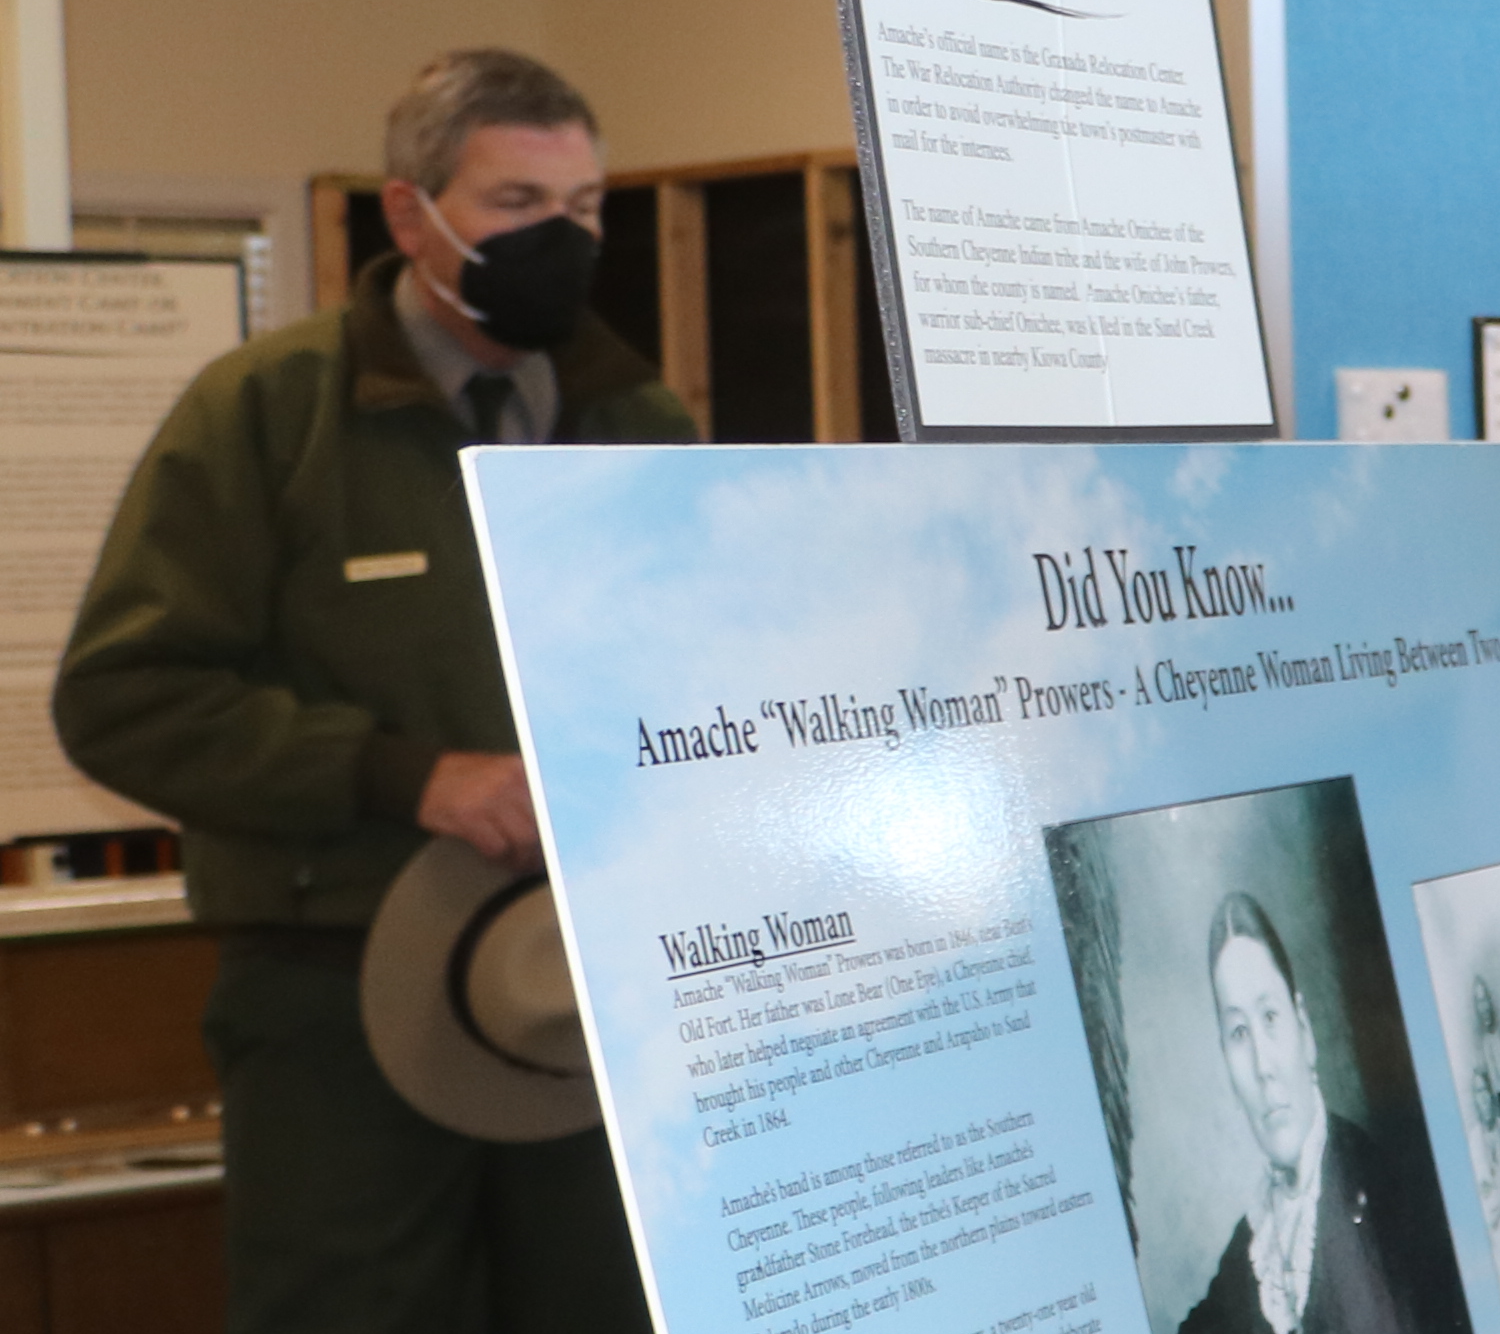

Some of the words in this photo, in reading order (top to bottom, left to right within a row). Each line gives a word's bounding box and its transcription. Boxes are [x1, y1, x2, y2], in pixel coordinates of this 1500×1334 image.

[1033, 546, 1108, 631] Did
[1104, 549, 1177, 624] You
[1173, 545, 1294, 619] Know...
[636, 706, 758, 767] Amache
[760, 694, 901, 747] “Walking
[896, 676, 1007, 732] Woman”
[1013, 676, 1114, 720] Prowers
[1134, 665, 1153, 706] A
[1153, 659, 1258, 703] Cheyenne
[1255, 650, 1335, 688] Woman
[1332, 642, 1397, 684] Living
[1392, 636, 1469, 674] Between
[658, 924, 766, 971] Walking
[761, 911, 854, 950] Woman
[673, 979, 725, 1009] Amache
[723, 969, 785, 994] “Walking
[780, 953, 832, 983] Woman”
[833, 950, 883, 973] Prowers
[882, 945, 906, 961] was
[903, 938, 935, 958] born
[933, 937, 948, 952] in
[678, 1017, 706, 1044] Old
[704, 1015, 738, 1038] Fort.
[736, 1007, 763, 1030] Her
[763, 999, 800, 1024] father
[800, 997, 825, 1014] was
[823, 989, 857, 1010] Lone
[854, 982, 883, 1003] Bear
[884, 974, 915, 999] (One
[1006, 944, 1035, 969] chief,
[686, 1054, 716, 1078] who
[714, 1050, 745, 1071] later
[744, 1034, 789, 1067] helped
[839, 1025, 857, 1041] an
[856, 1009, 916, 1042] agreement
[914, 998, 942, 1021] with
[941, 995, 961, 1016] the
[958, 989, 984, 1011] U.S.
[985, 986, 1014, 1005] Army
[1014, 979, 1037, 998] that
[692, 1082, 746, 1114] brought
[744, 1078, 767, 1100] his
[766, 1066, 808, 1102] people
[808, 1058, 833, 1084] and
[833, 1053, 865, 1078] other
[864, 1042, 922, 1070] Cheyenne
[922, 1030, 945, 1055] and
[946, 1021, 991, 1051] Arapaho
[1003, 1009, 1032, 1034] Sand
[702, 1118, 742, 1147] Creek
[741, 1117, 758, 1138] in
[757, 1108, 792, 1133] 1864.
